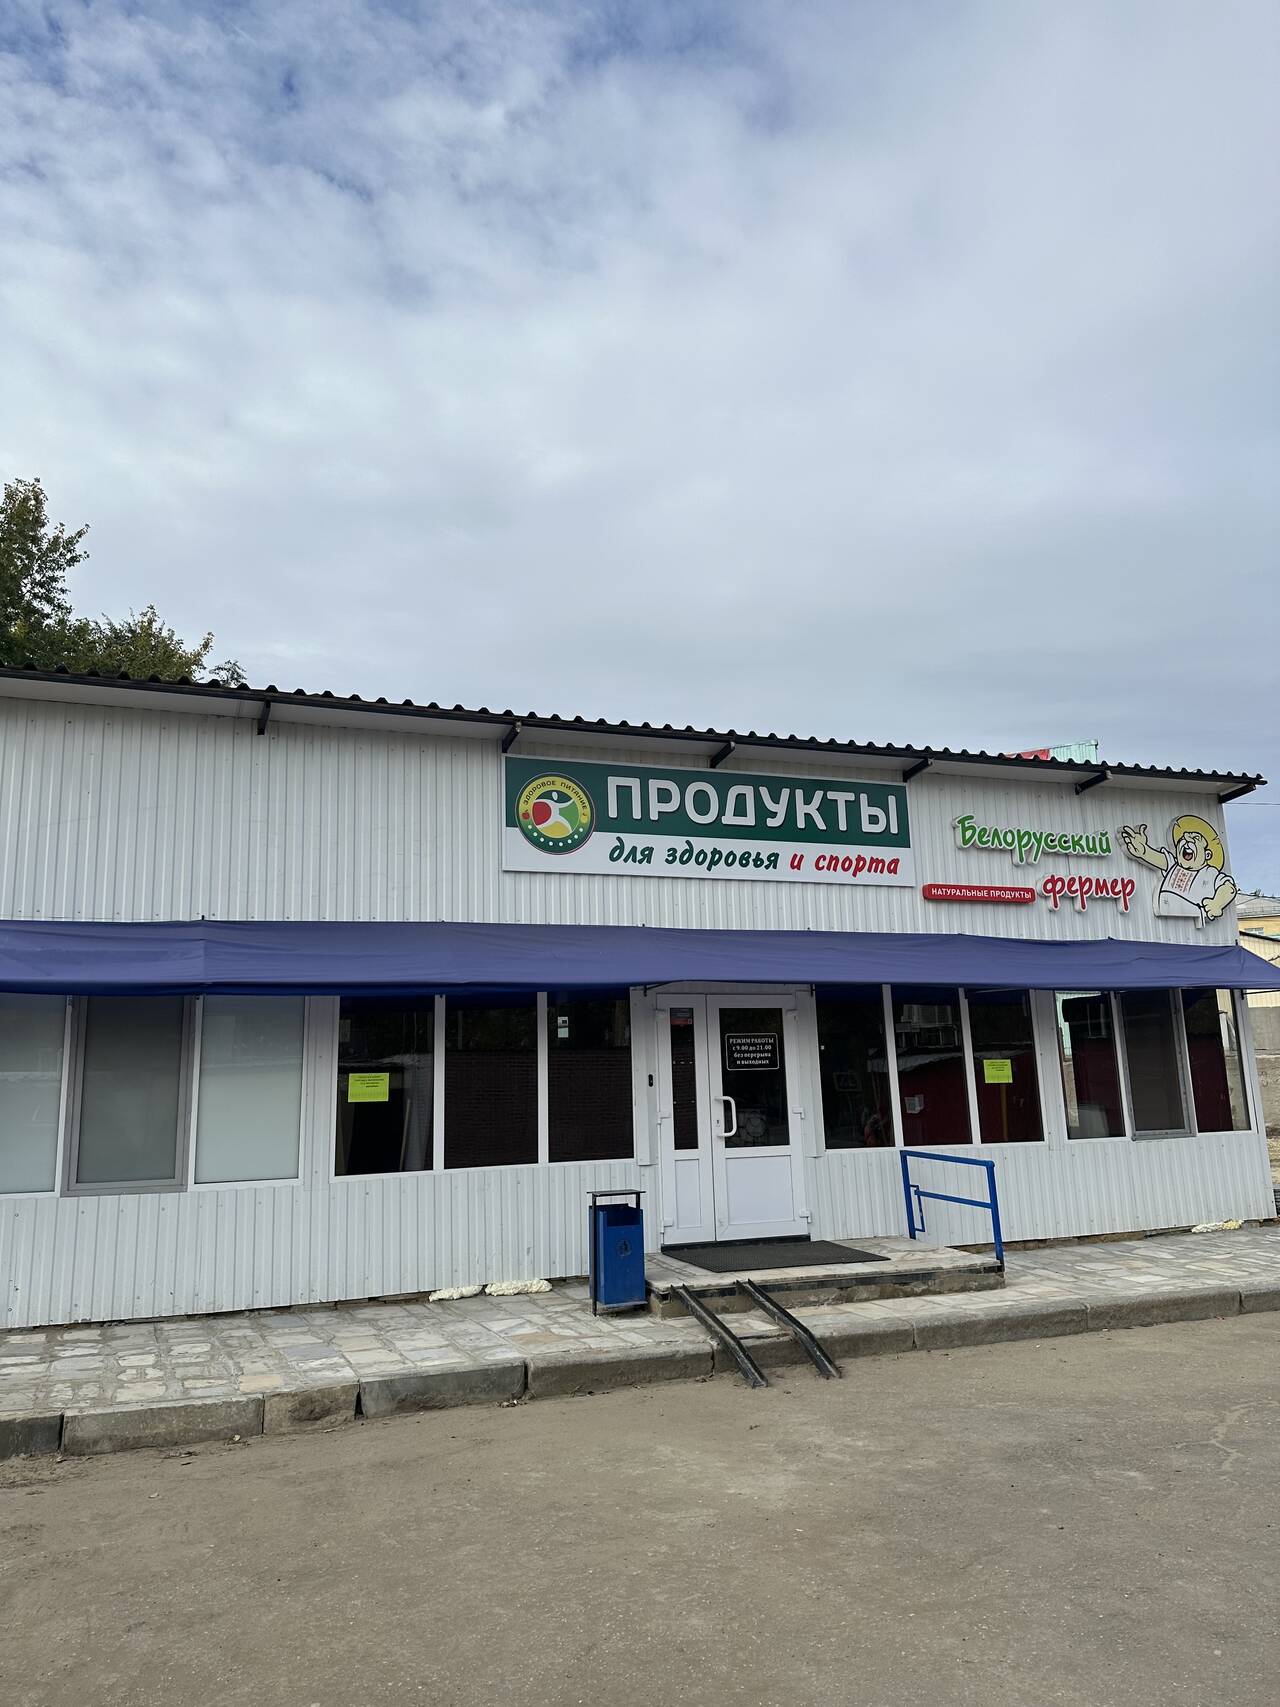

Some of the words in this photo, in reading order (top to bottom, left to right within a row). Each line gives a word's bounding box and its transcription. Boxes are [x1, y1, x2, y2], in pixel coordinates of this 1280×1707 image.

[523, 780, 557, 806] ЗДОРОВОЕ
[560, 781, 588, 810] ПИТАНИЕ
[607, 775, 899, 835] ПРОДУКТЫ
[608, 836, 654, 865] для
[665, 839, 780, 872] здоровья
[789, 854, 804, 871] и
[814, 853, 900, 878] спорта
[956, 814, 1112, 863] Белорусский
[931, 887, 989, 898] НАТУРАЛЬНЫЕ
[990, 889, 1032, 900] ПРОДУКТЫ
[1041, 873, 1136, 912] фермер
